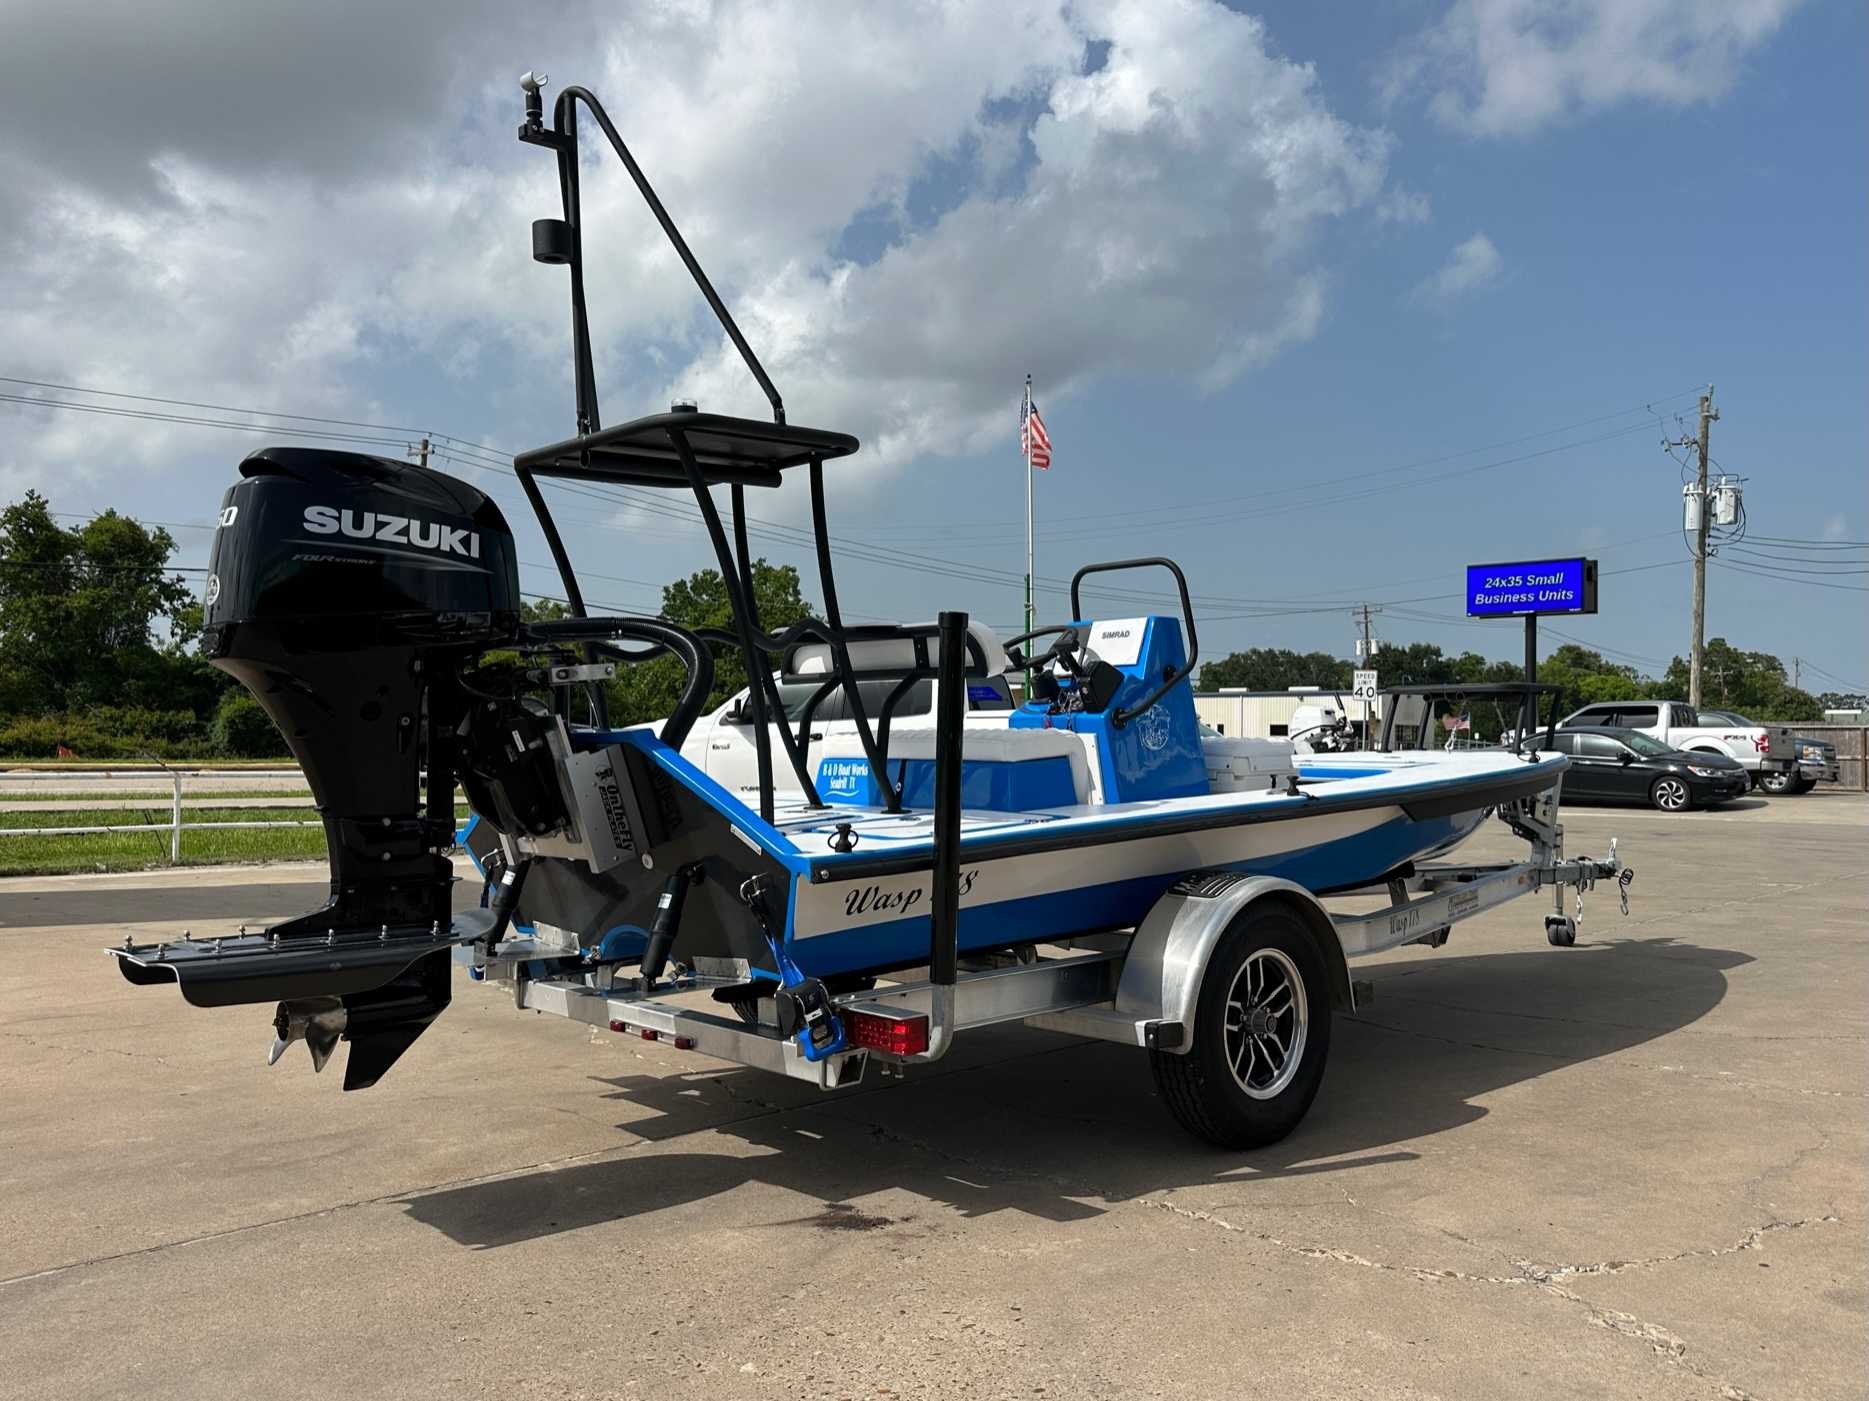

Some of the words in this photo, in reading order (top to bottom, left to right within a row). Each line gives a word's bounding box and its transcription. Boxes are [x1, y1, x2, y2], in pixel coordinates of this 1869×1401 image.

[302, 505, 480, 559] SUZUKI
[1484, 576, 1523, 589] 24x35
[1526, 572, 1564, 586] Small
[1475, 591, 1535, 605] Business
[1539, 588, 1575, 602] Units
[1101, 630, 1131, 640] SIMRAD
[1354, 686, 1375, 699] 40
[838, 763, 851, 776] Boat
[851, 762, 869, 777] Works
[845, 885, 923, 917] Wasp
